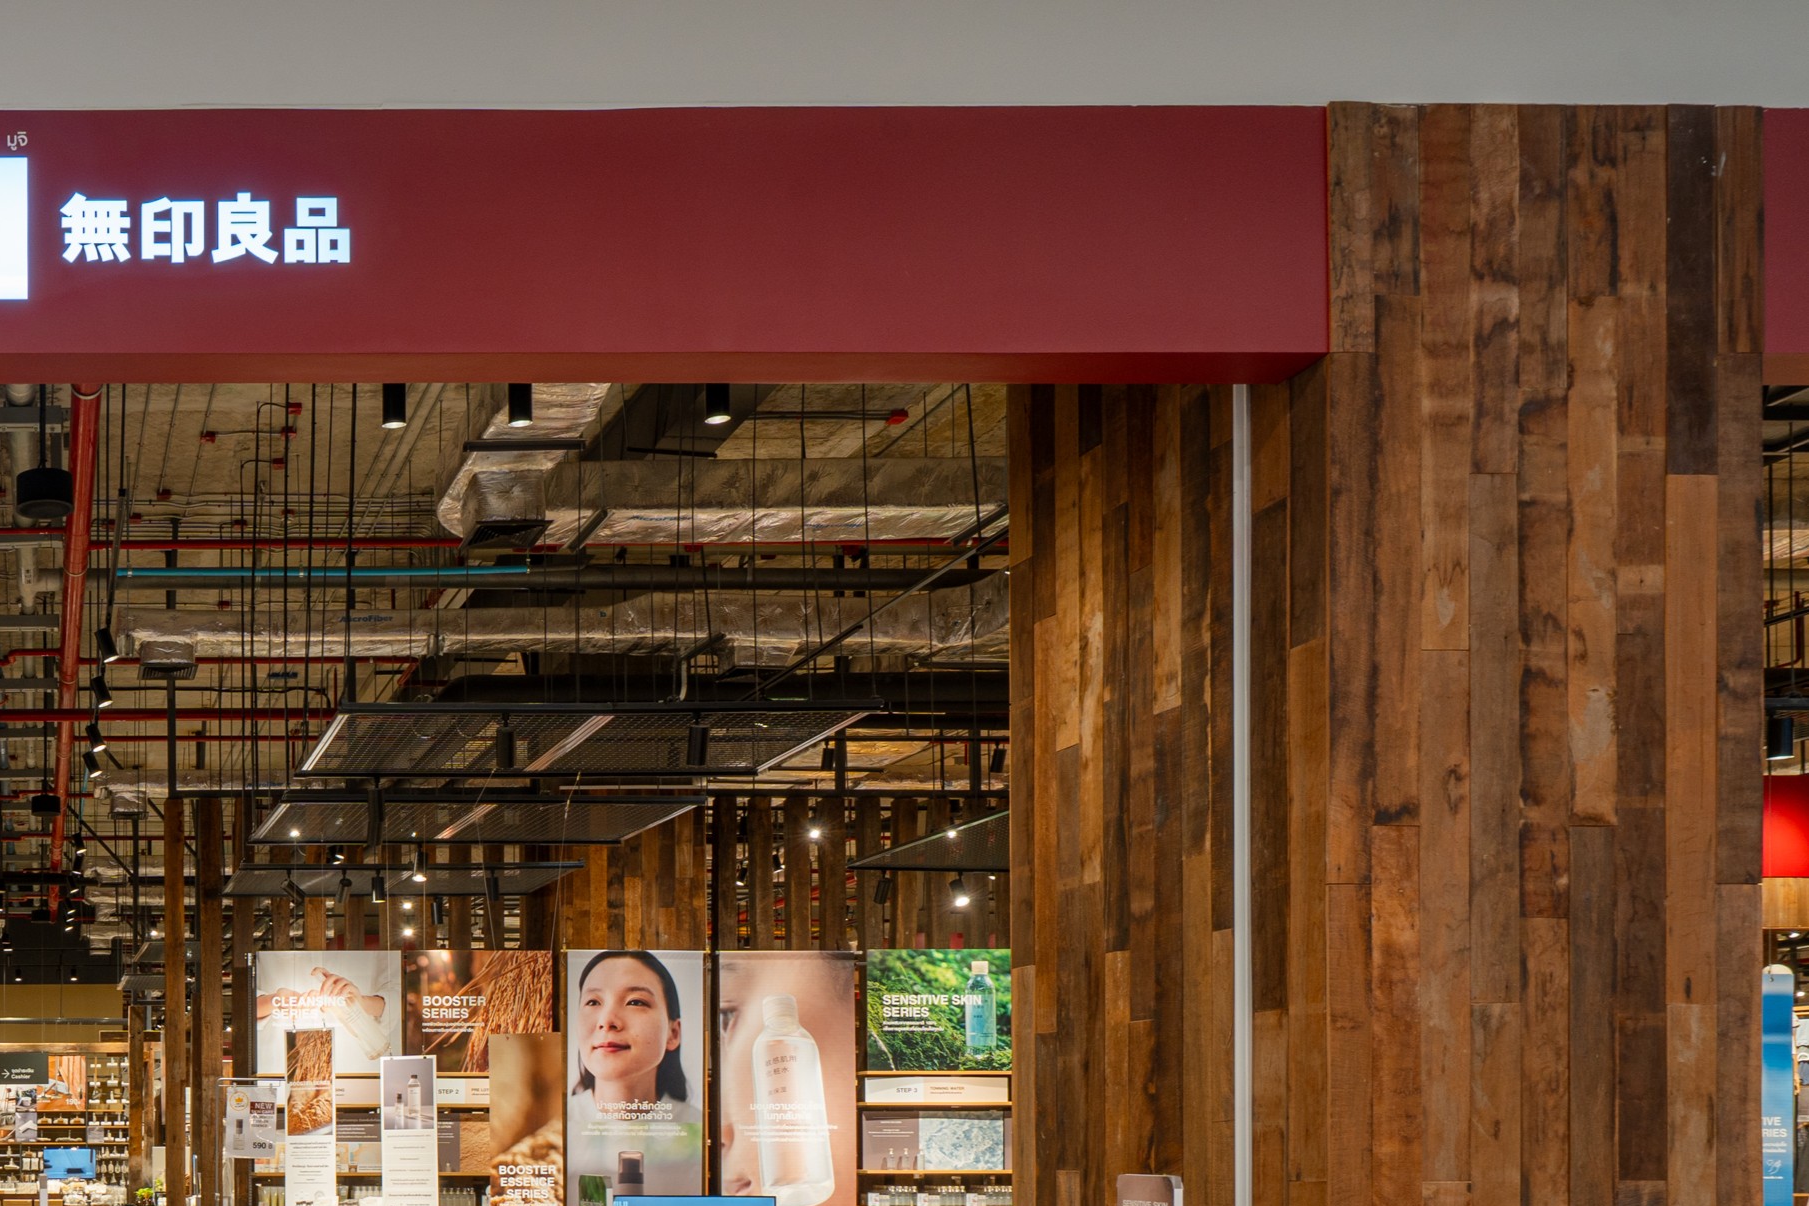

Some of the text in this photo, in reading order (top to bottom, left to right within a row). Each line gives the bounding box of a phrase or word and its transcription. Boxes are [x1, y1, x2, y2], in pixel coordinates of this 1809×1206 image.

[6, 131, 28, 151] มูจิ
[60, 192, 351, 264] 無印良品
[271, 996, 347, 1007] CLEANSING
[422, 996, 486, 1007] BOOSTER
[882, 994, 982, 1005] SENSITIVE SKIN
[271, 1008, 320, 1020] SERIES
[422, 1008, 469, 1019] SERIES
[882, 1006, 930, 1018] SERIES
[1762, 1128, 1788, 1138] RIES
[499, 1165, 557, 1175] BOOSTER
[500, 1177, 555, 1187] ESSENCE
[506, 1189, 549, 1199] SERIES
